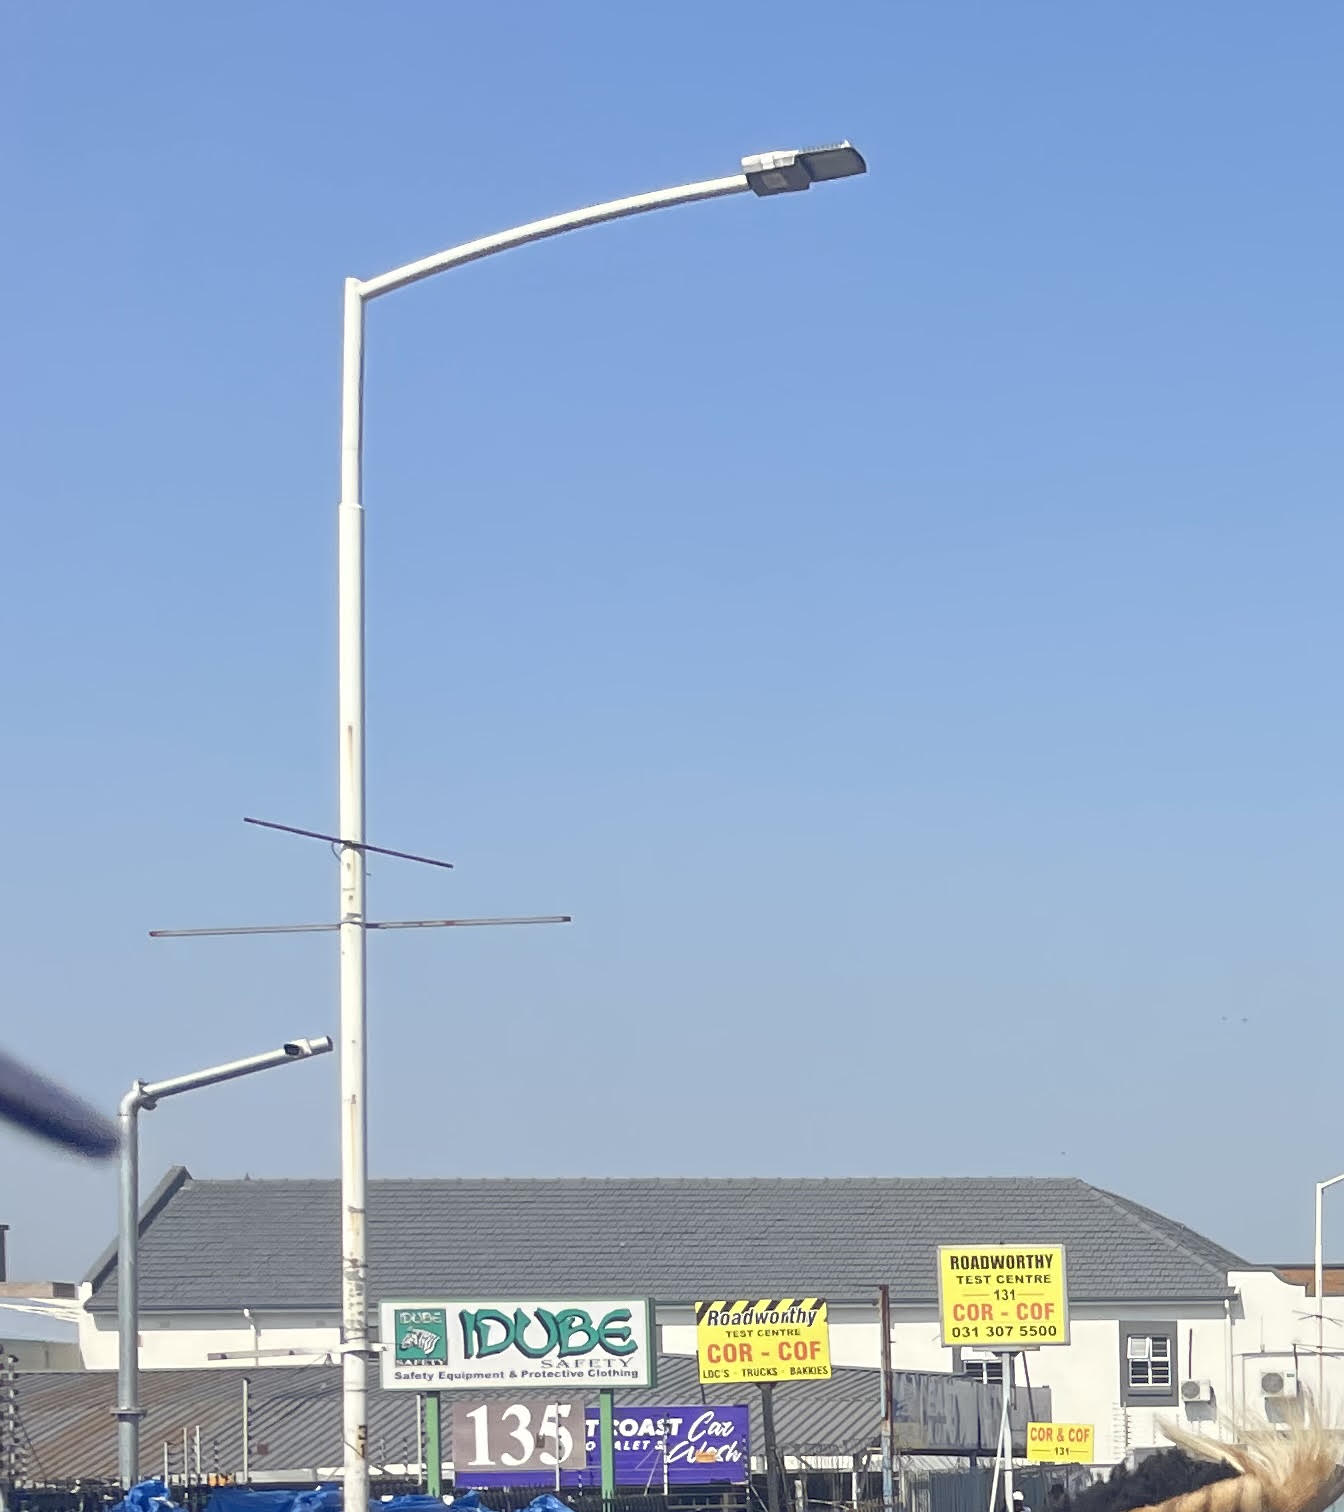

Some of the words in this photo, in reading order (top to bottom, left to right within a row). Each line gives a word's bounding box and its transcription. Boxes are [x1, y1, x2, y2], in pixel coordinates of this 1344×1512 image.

[950, 1254, 1053, 1270] ROADWORTHY
[956, 1275, 991, 1284] TEST
[996, 1274, 1051, 1284] CENTRE
[993, 1289, 1016, 1300] 131
[707, 1306, 817, 1327] Roadworthy
[953, 1303, 993, 1321] COR
[1016, 1302, 1054, 1320] COF
[459, 1308, 638, 1359] IDUBE
[725, 1330, 754, 1338] TEST
[757, 1328, 801, 1337] CENTRE
[952, 1326, 979, 1337] 031
[986, 1325, 1013, 1337] 307
[1019, 1325, 1057, 1336] 5500
[707, 1343, 753, 1363] COR
[778, 1341, 821, 1361] COF
[541, 1357, 633, 1368] SAFETY
[394, 1371, 434, 1381] Safety
[438, 1371, 504, 1380] Equipment
[509, 1370, 517, 1378] &
[521, 1370, 584, 1378] Protective
[588, 1369, 638, 1378] Clothing
[742, 1367, 778, 1377] TRUCKS
[790, 1365, 829, 1375] BAKKIES
[688, 1410, 735, 1442] Car
[464, 1404, 573, 1466] 135
[1030, 1427, 1053, 1441] COR
[1068, 1429, 1090, 1442] COF
